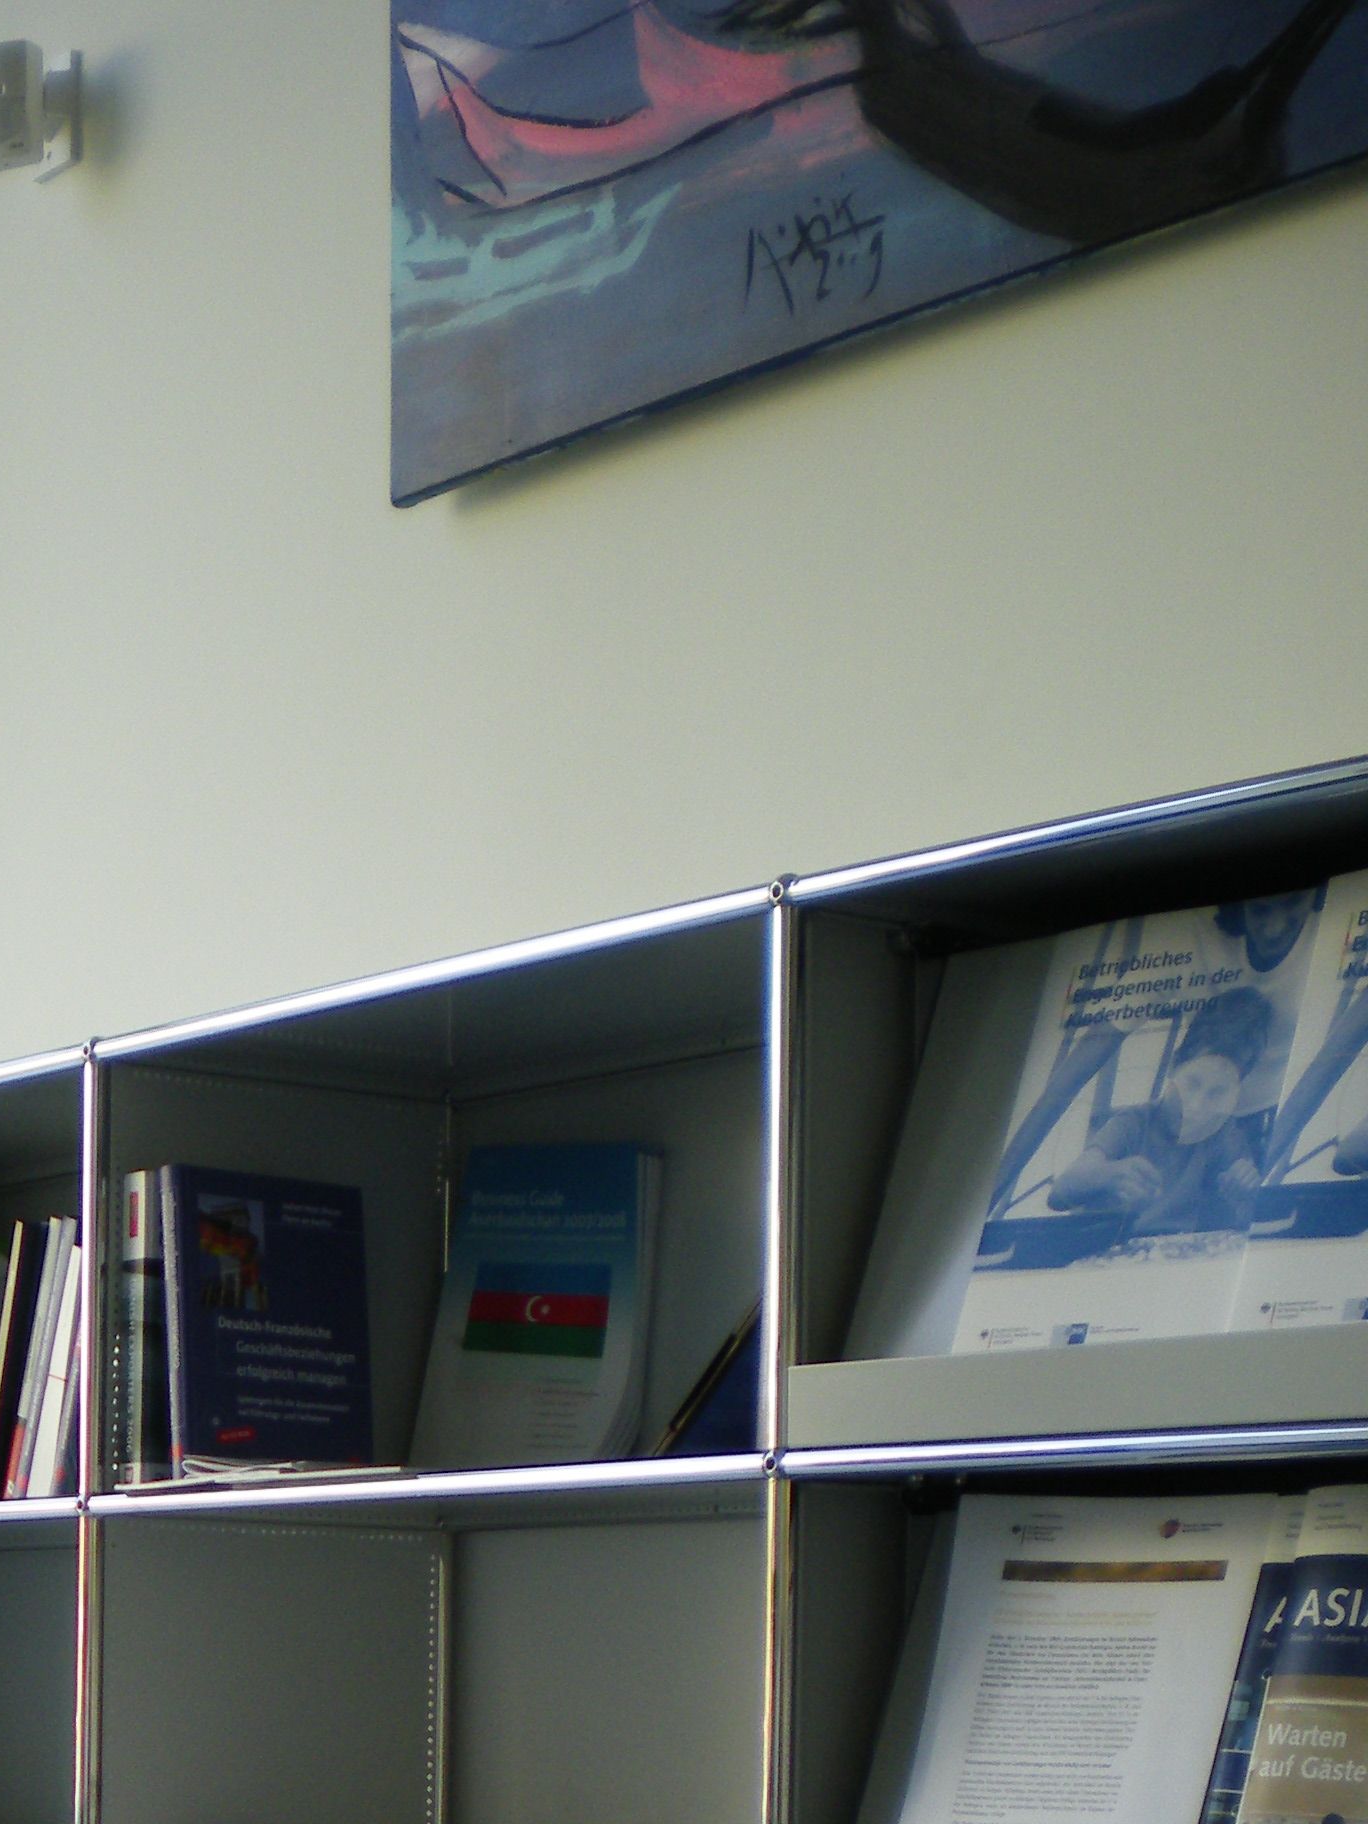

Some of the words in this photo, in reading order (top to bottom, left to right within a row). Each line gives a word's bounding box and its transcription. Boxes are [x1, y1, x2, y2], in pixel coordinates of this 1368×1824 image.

[1078, 950, 1193, 980] Betriebliches
[1073, 975, 1183, 1005] Engagement
[1187, 971, 1205, 988] in
[1211, 967, 1244, 985] der
[1267, 1722, 1348, 1748] Warten
[1258, 1754, 1296, 1778] auf
[1300, 1756, 1368, 1783] Gäste
